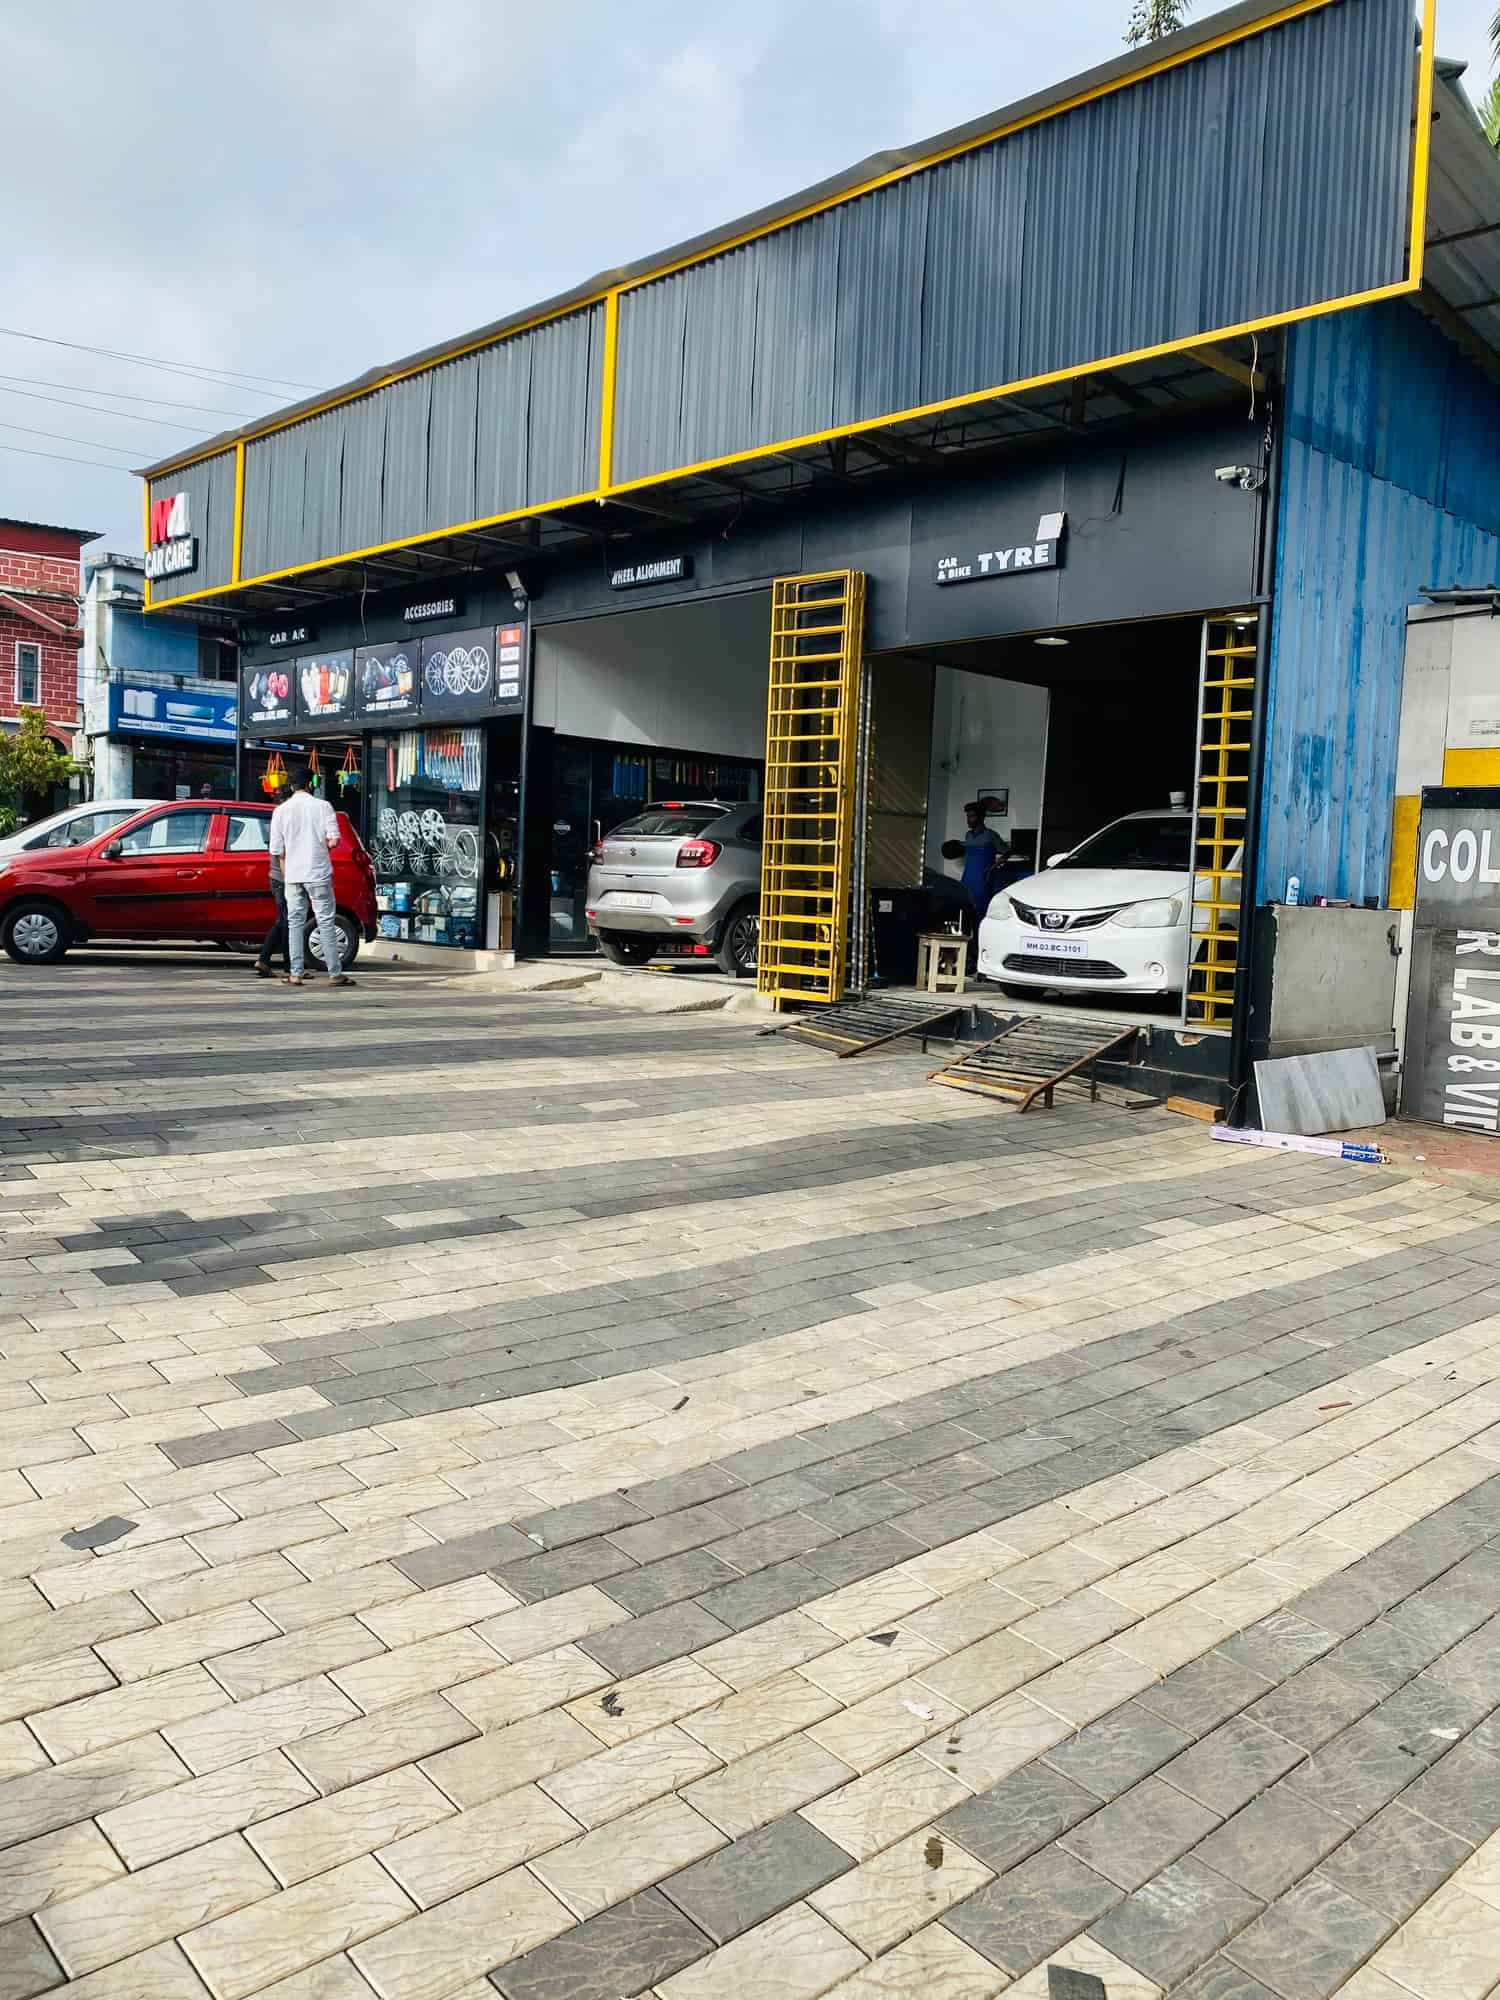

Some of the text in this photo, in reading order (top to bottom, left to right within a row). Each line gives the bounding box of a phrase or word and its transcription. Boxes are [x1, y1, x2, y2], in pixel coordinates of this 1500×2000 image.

[145, 539, 193, 578] CAR CARE
[635, 558, 681, 581] ALIGNMENT
[937, 543, 1049, 580] & BIKE TYRE
[938, 557, 958, 569] CAR
[404, 599, 454, 620] ACCESSORIES
[269, 631, 287, 644] CAR
[1423, 829, 1500, 883] COL
[1450, 968, 1500, 1049] LAB
